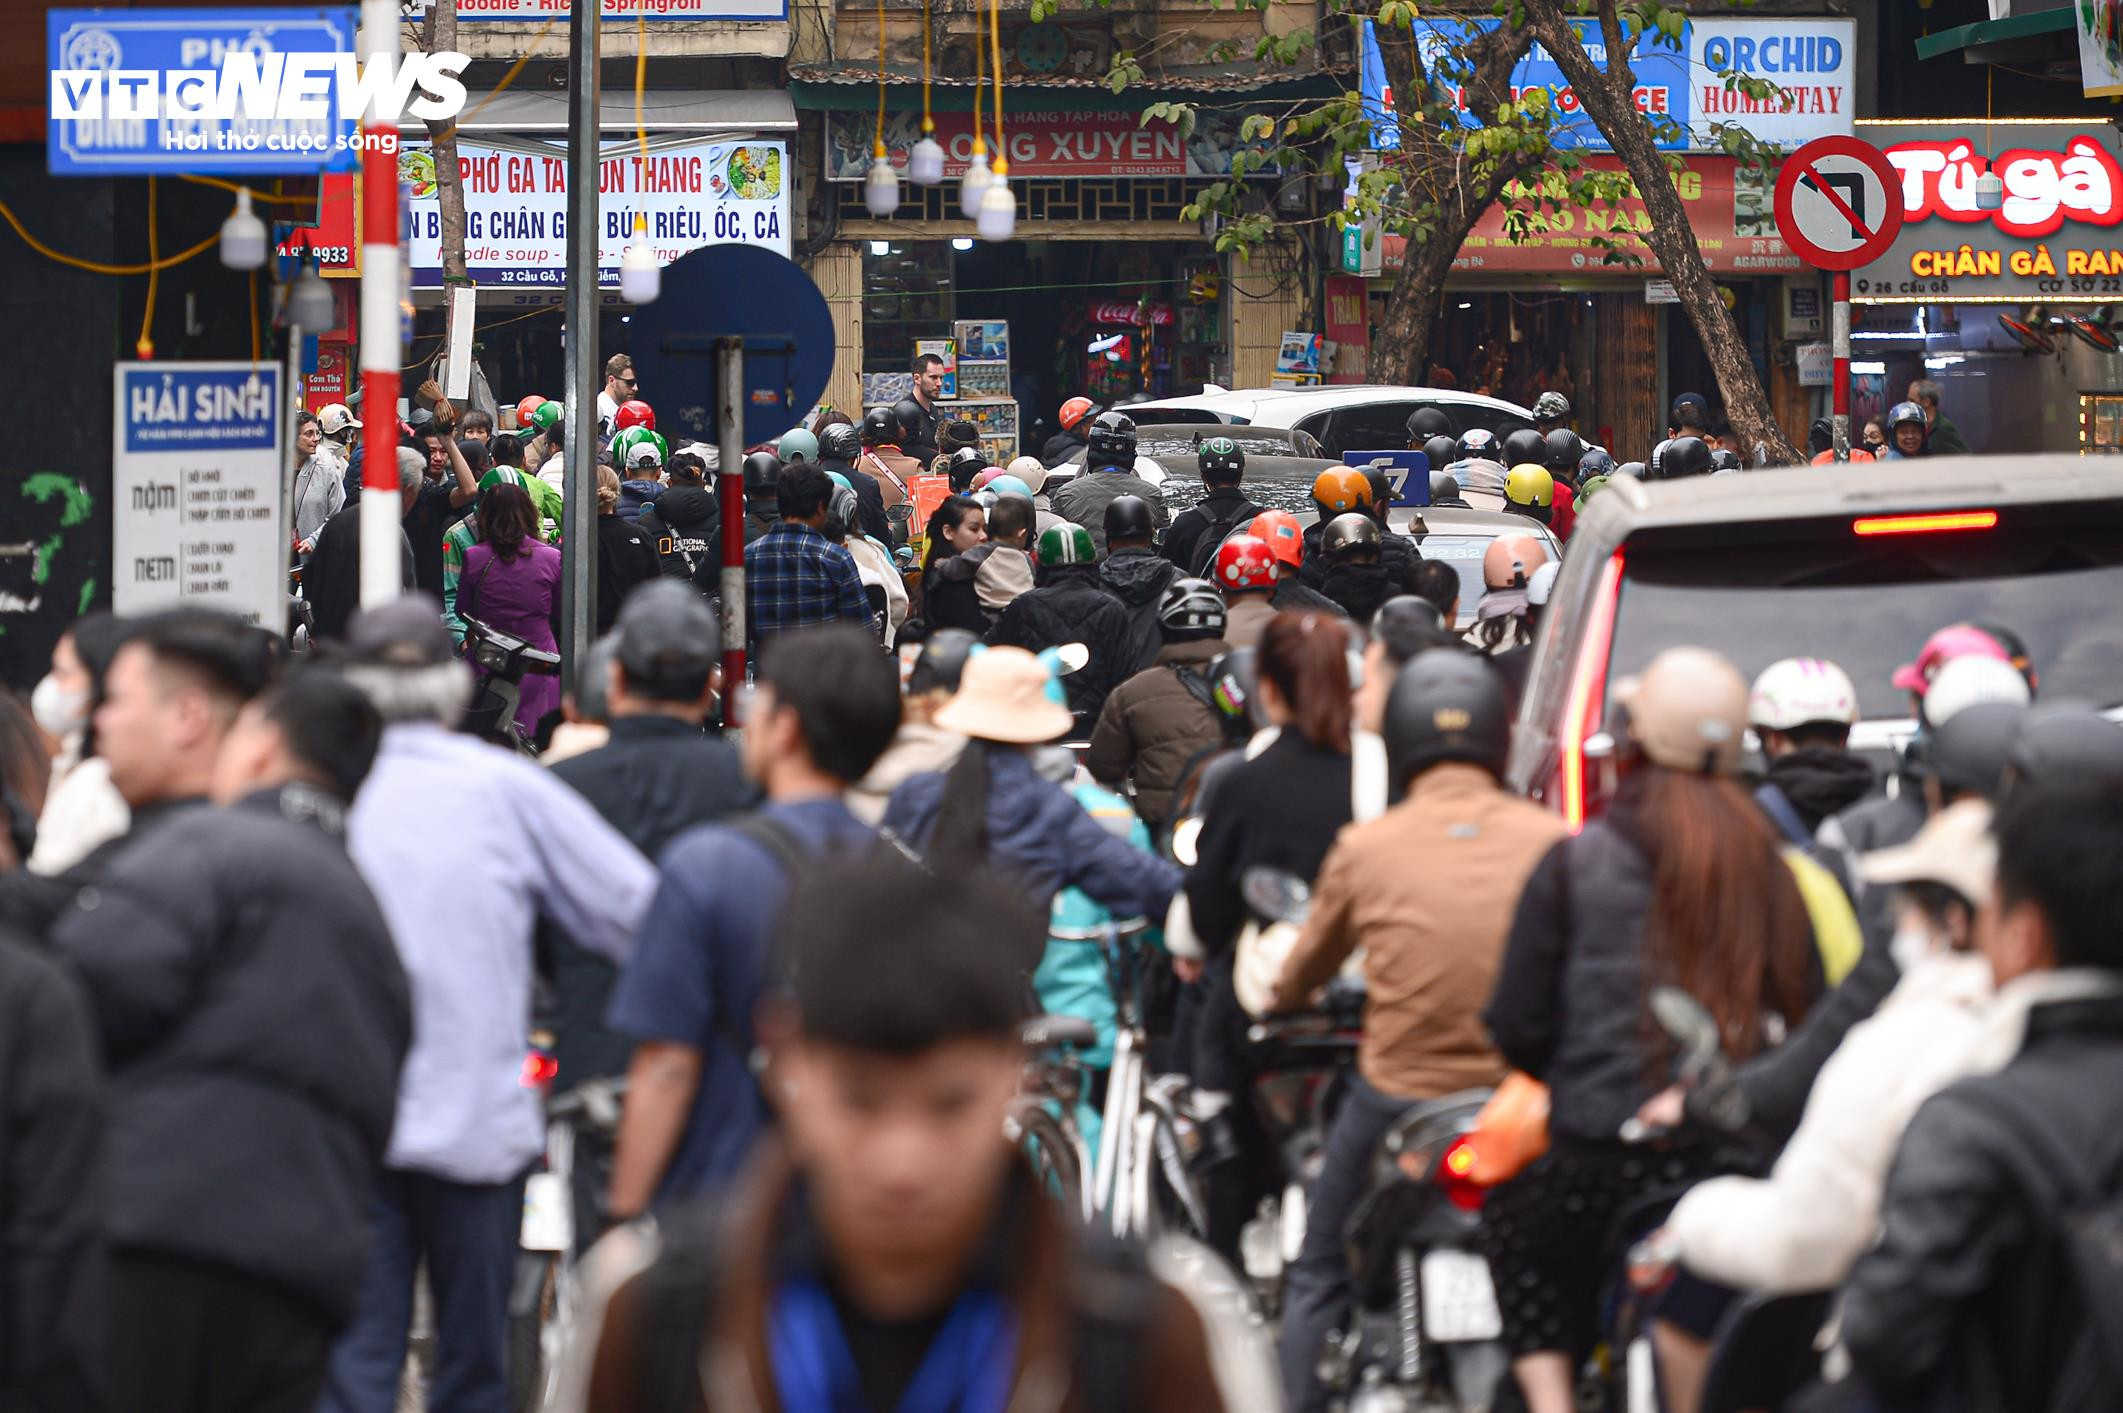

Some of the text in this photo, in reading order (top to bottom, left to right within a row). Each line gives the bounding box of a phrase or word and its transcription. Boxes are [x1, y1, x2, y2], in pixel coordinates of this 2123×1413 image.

[1703, 36, 1842, 73] ORCHID
[631, 156, 702, 193] THANG
[2001, 143, 2113, 225] gà
[490, 205, 544, 239] CHÂN
[655, 205, 707, 242] RIÊU,
[714, 201, 747, 242] ỐC,
[754, 205, 780, 239] CÁ
[505, 249, 548, 264] soup
[1911, 243, 2000, 276] CHÂN
[2009, 243, 2056, 276] GÀ
[501, 271, 513, 282] 32
[1874, 281, 1892, 294] 26
[131, 373, 271, 423] HẢI SINH
